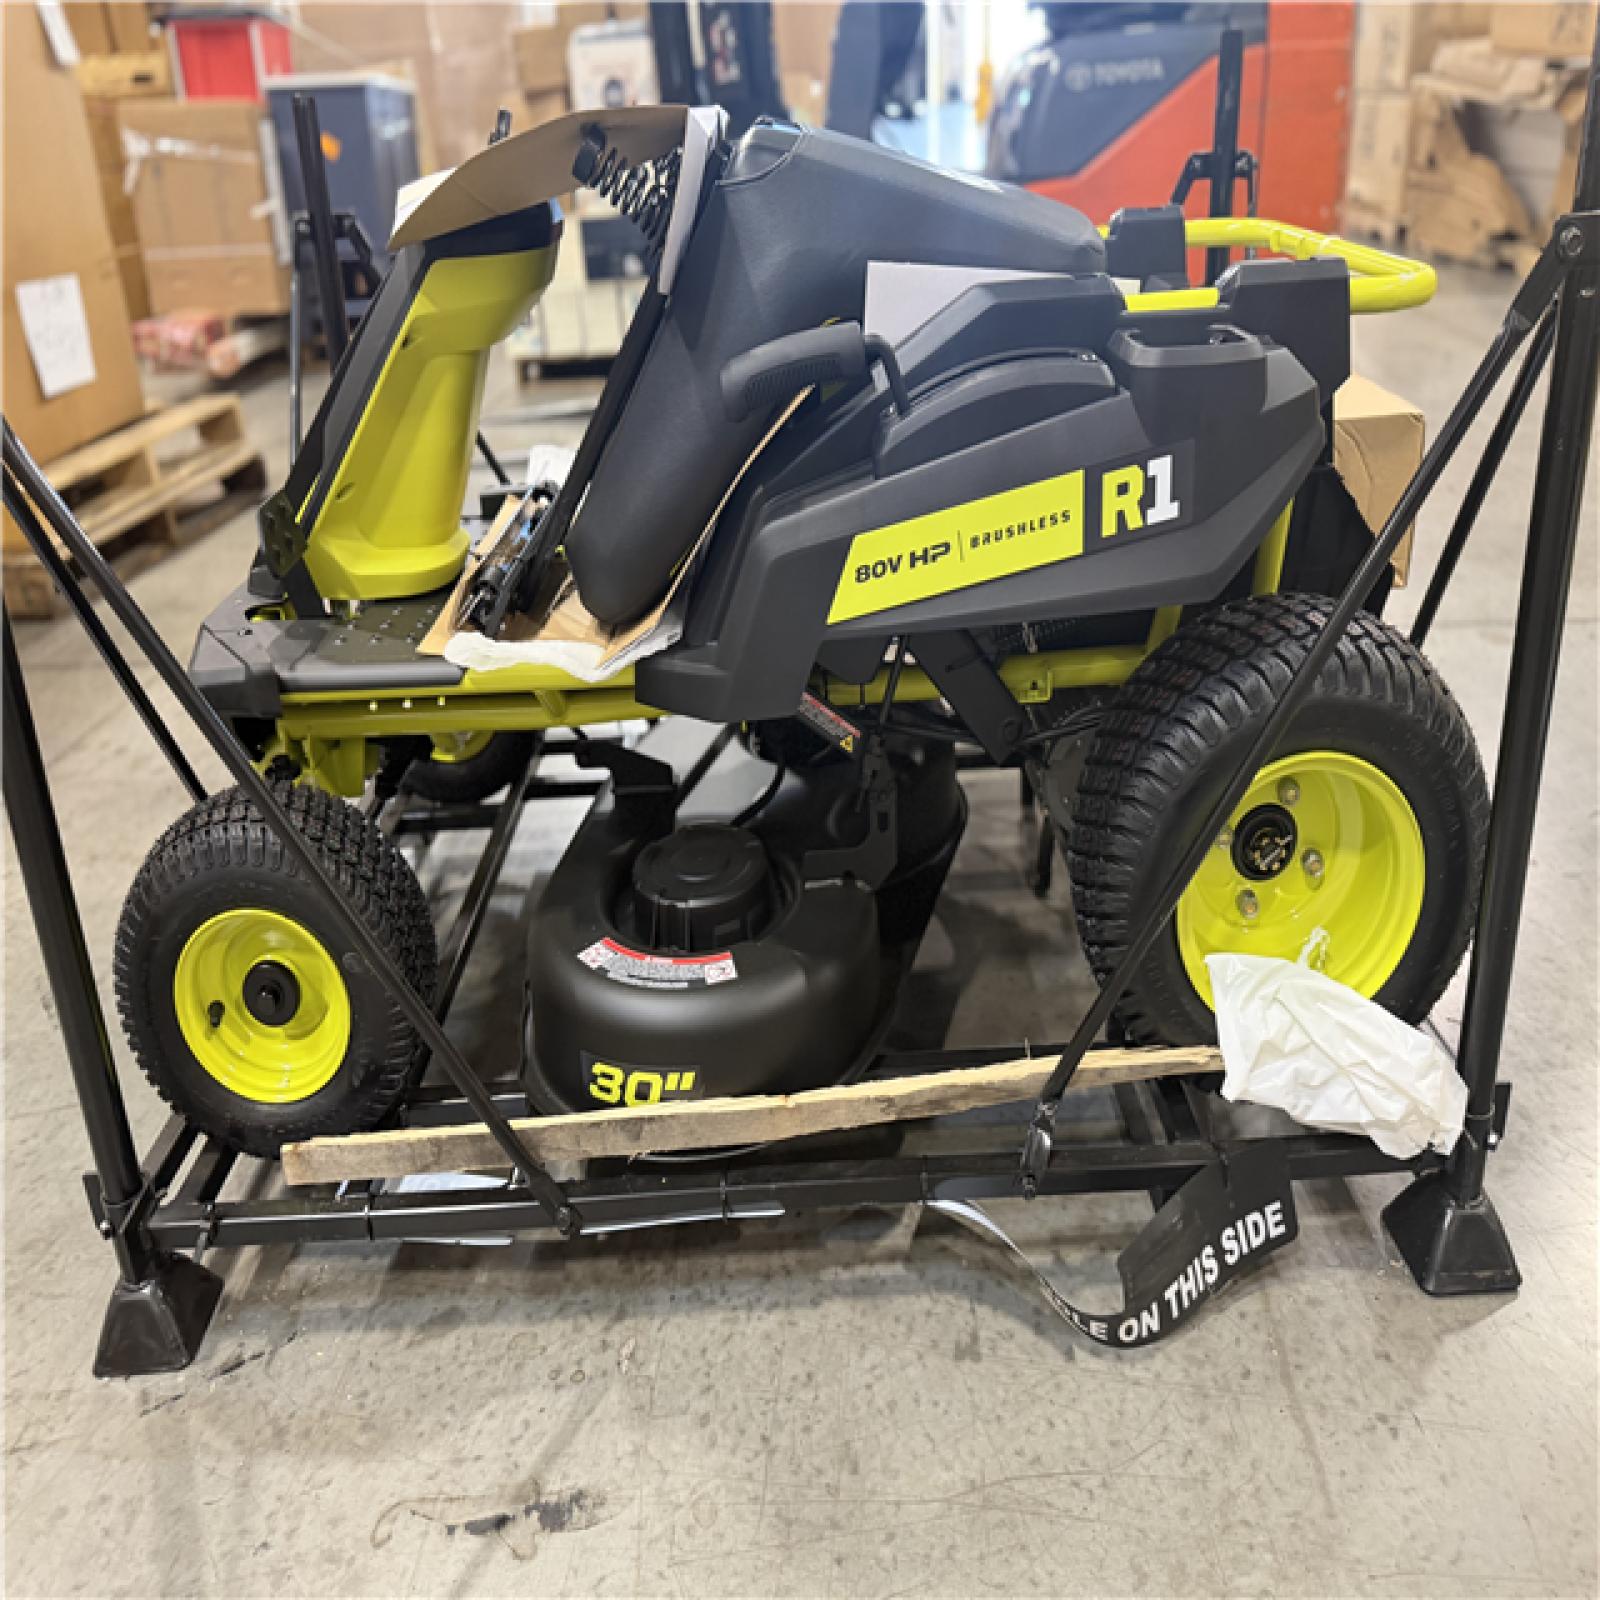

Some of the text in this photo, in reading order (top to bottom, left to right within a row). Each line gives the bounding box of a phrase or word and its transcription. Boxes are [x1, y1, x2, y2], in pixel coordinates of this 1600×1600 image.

[1101, 454, 1180, 538] R1
[854, 509, 1071, 583] 80V HP BRUSHLESS
[589, 1062, 696, 1107] 30"
[1117, 1302, 1160, 1343] ON
[1164, 1245, 1219, 1319] THIS
[1221, 1200, 1286, 1265] SIDE
